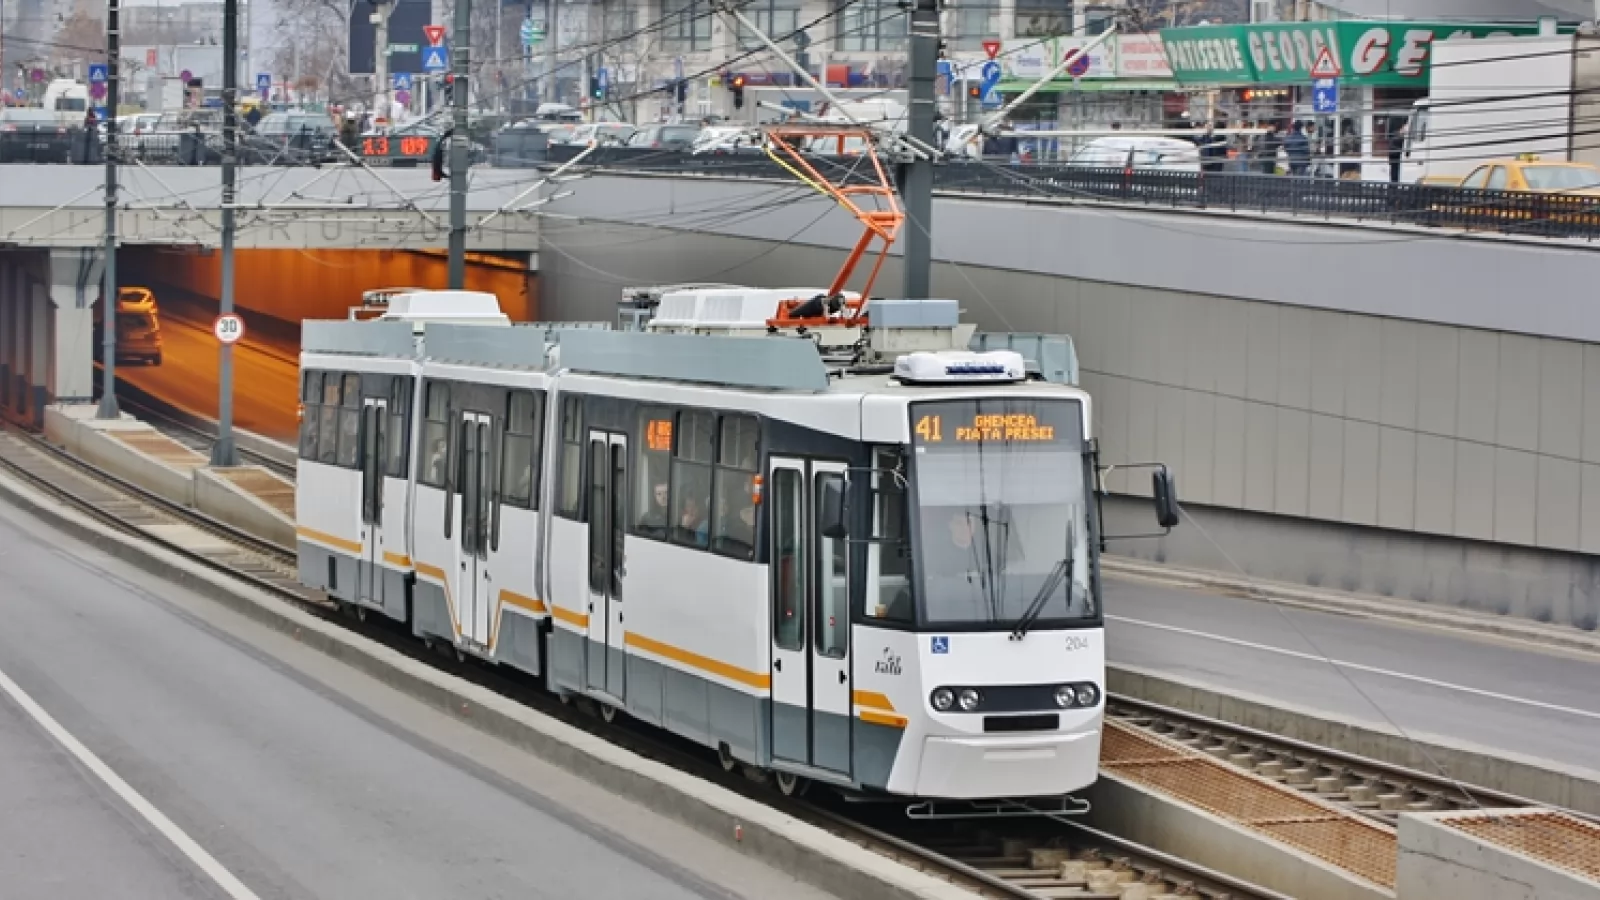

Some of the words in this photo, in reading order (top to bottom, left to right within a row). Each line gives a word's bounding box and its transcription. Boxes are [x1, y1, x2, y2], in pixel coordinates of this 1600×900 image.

[1165, 38, 1245, 71] PATISERIE
[1248, 28, 1341, 72] GEORGI
[362, 137, 388, 155] 13
[220, 319, 237, 332] 30
[915, 415, 943, 442] 41
[974, 414, 1037, 428] GHENCEA
[955, 427, 1002, 440] PIATA
[1005, 427, 1054, 440] PRESEI
[1065, 636, 1089, 651] 204
